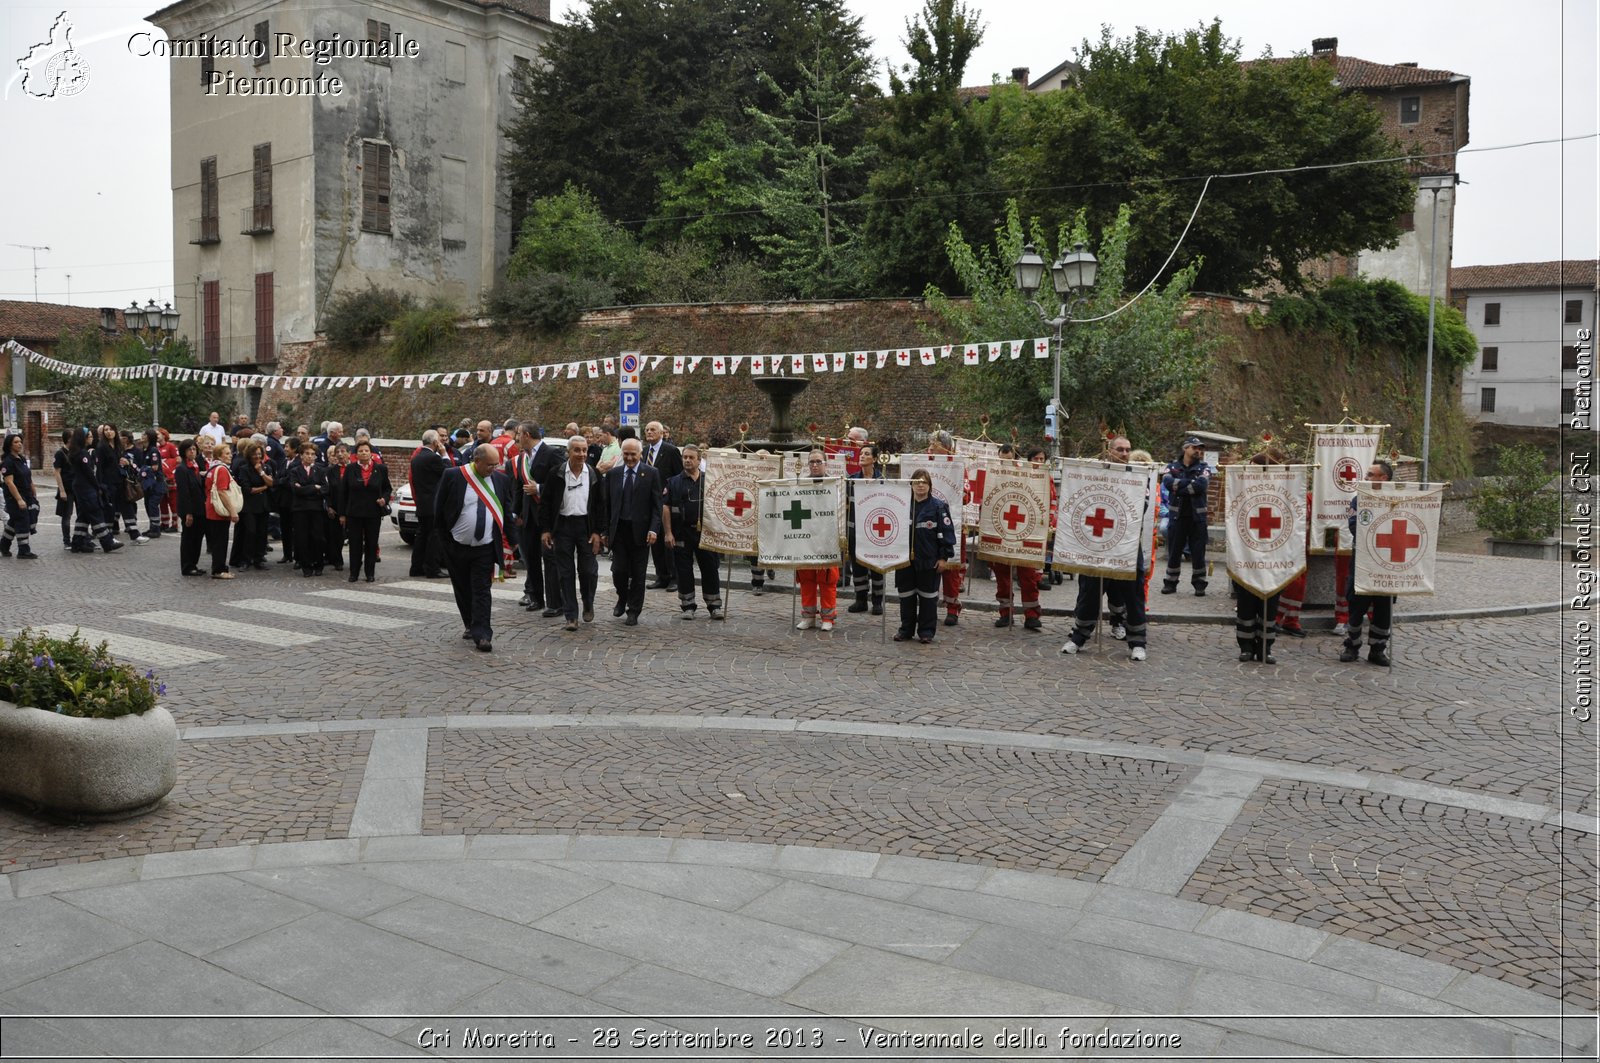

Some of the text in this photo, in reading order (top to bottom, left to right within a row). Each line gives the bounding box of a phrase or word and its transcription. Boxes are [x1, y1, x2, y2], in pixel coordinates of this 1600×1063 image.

[624, 392, 636, 412] P
[1001, 480, 1024, 490] ROSSA
[1246, 484, 1276, 494] ROSSA
[795, 489, 831, 497] ASSISTENZA
[1062, 483, 1139, 521] CROCE ROSSA ITALIANA
[1058, 551, 1094, 563] GRUPPO
[1108, 558, 1130, 567] ALBA
[1236, 560, 1295, 570] SAVIGLIANO
[1373, 580, 1418, 589] MORETTA
